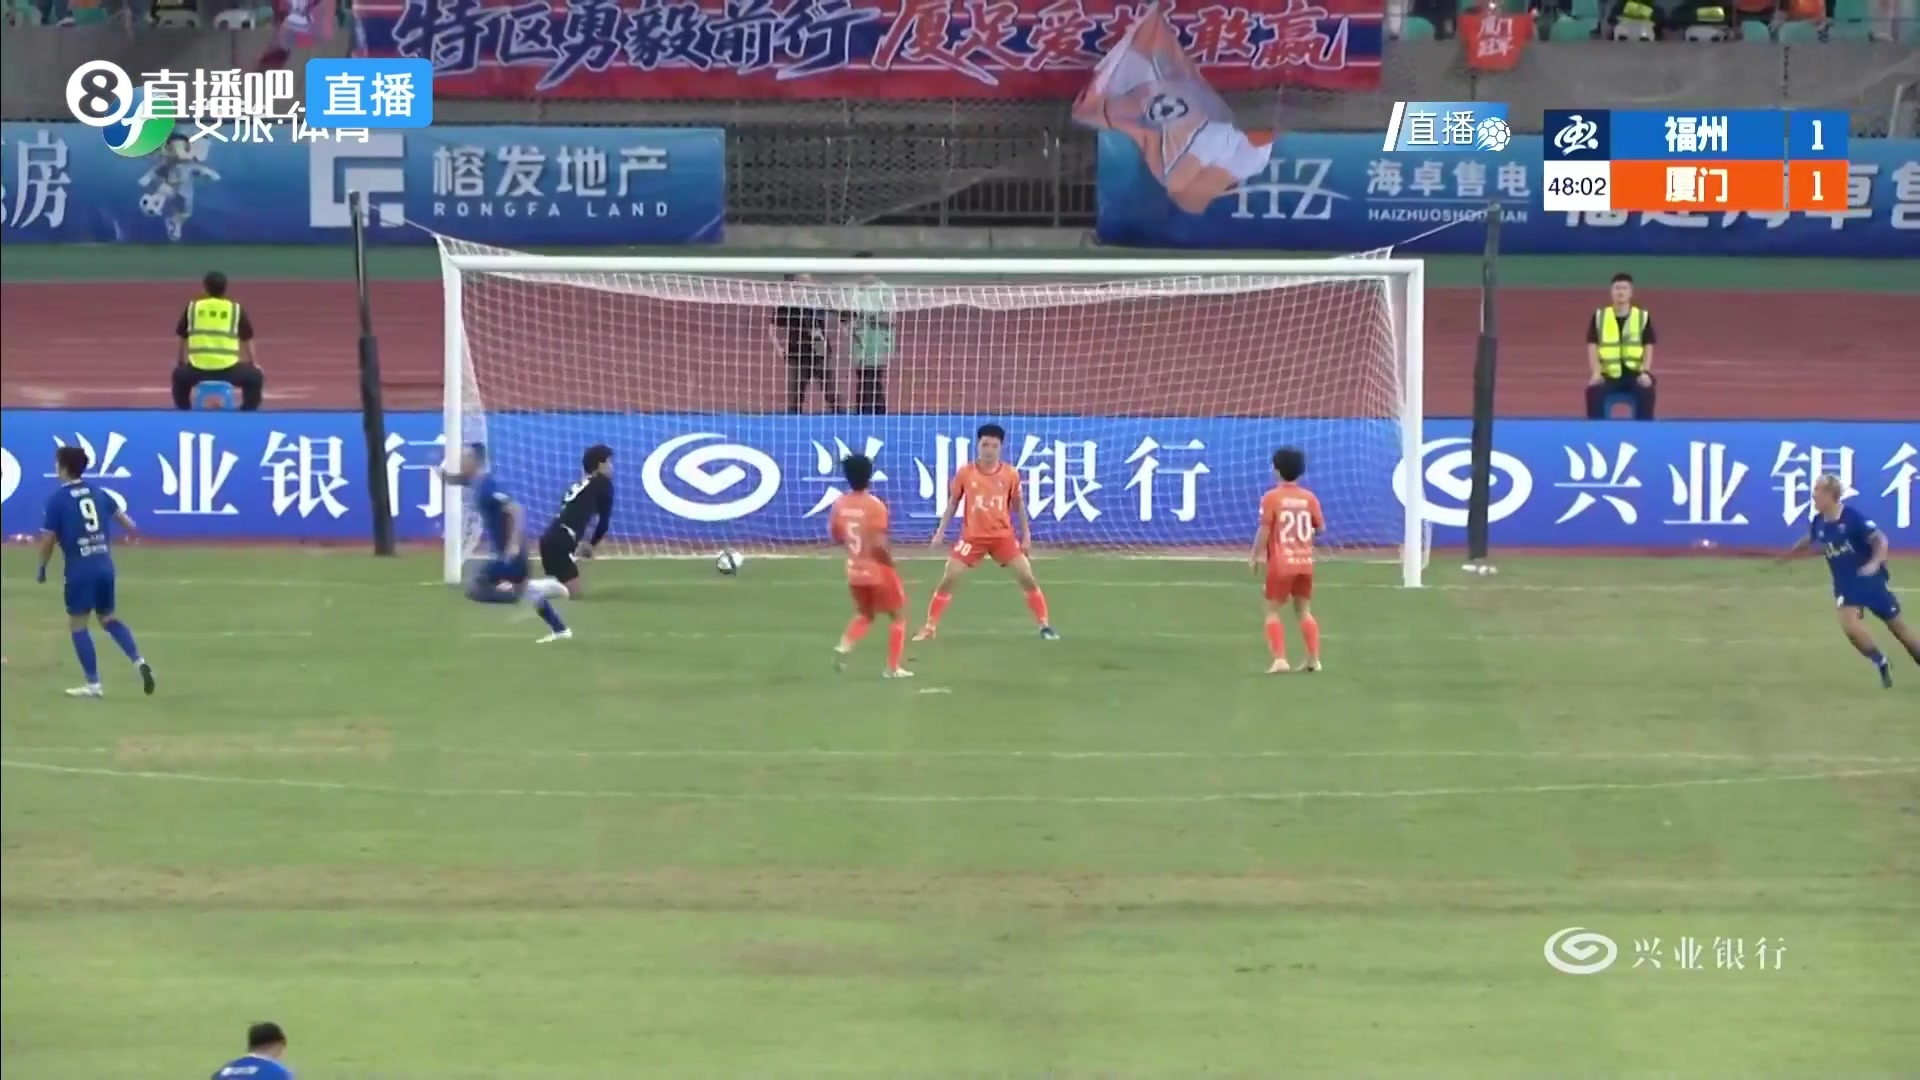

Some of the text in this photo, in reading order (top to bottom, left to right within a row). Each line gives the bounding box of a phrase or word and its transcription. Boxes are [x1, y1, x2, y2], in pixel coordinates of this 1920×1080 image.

[392, 0, 881, 91] 特区勇毅前行
[0, 129, 72, 230] 房
[432, 145, 669, 197] 榕发地产
[1366, 158, 1532, 198] 海卓售电
[433, 201, 669, 218] RONGFA LAND
[1367, 207, 1529, 223] HAIZHUOSHOIAN
[79, 497, 99, 533] 9
[1279, 510, 1313, 544] 20
[847, 520, 862, 556] 5
